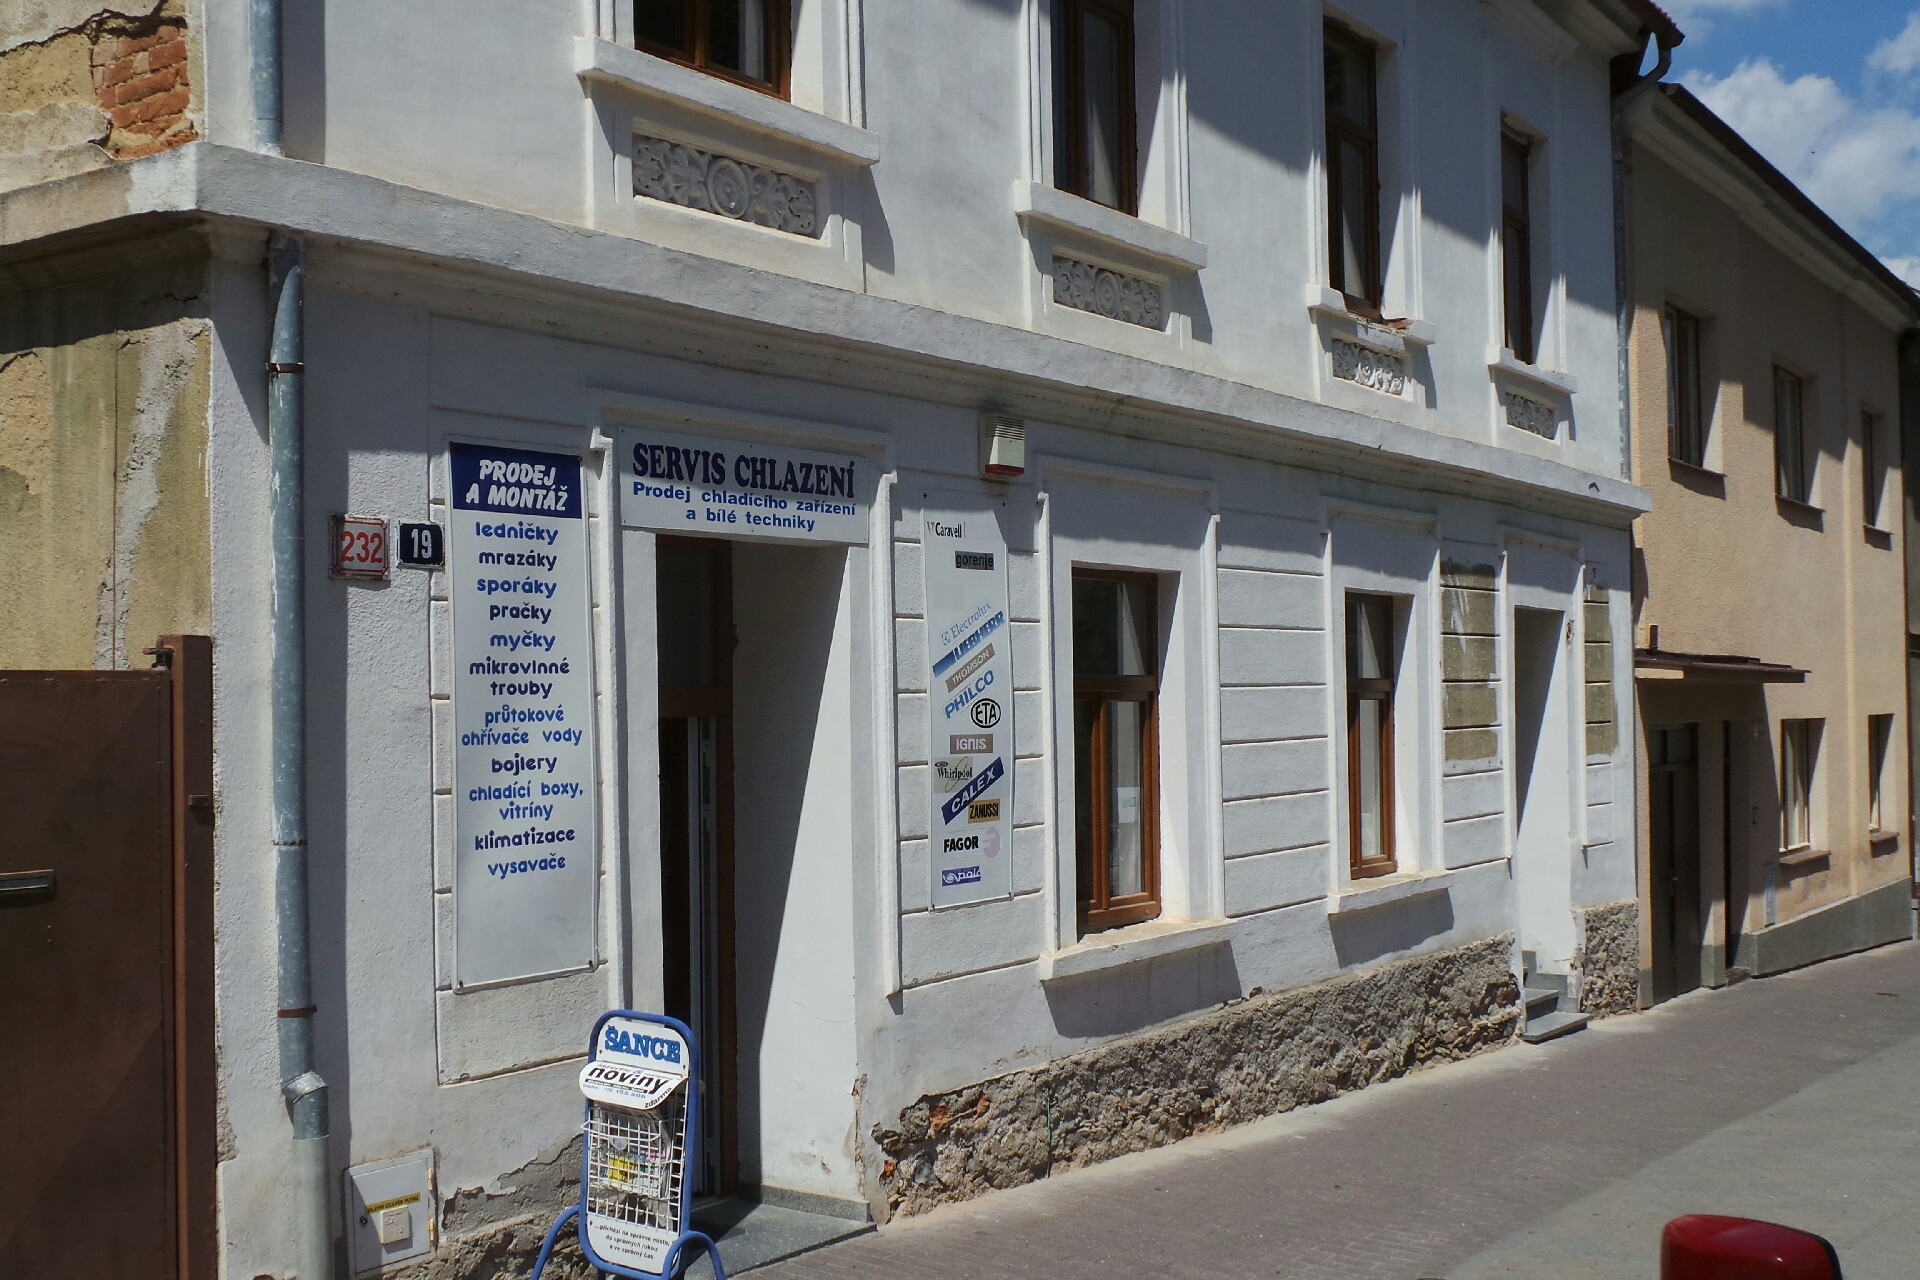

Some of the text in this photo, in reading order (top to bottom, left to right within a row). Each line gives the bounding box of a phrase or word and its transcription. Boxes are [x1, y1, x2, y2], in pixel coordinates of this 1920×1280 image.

[479, 459, 556, 486] PRODEJ
[632, 442, 855, 498] SERVIS CHLAZENÍ
[465, 483, 568, 511] A MONTÁŽ
[633, 481, 856, 516] Prodej chladícího zařízení
[686, 508, 816, 532] a bílé techniky
[935, 521, 962, 538] Caravell
[411, 528, 432, 559] 19
[475, 521, 559, 545] ledničky
[341, 530, 383, 564] 232
[478, 550, 557, 571] mrazáky
[956, 553, 994, 570] gorenje
[477, 575, 557, 598] sporáky
[490, 602, 552, 625] pračky
[950, 603, 991, 639] Electrolux
[490, 630, 556, 652] myčky
[952, 610, 1005, 661] LIEBHERR
[469, 656, 570, 675] mikrovlnné
[952, 649, 990, 685] THOMSON
[490, 680, 553, 699] trouby
[945, 670, 995, 719] PHILCO
[484, 704, 564, 727] průtokové
[975, 702, 997, 725] ETA
[461, 727, 583, 747] ohřívače vody
[491, 753, 558, 776] bojlery
[937, 766, 973, 780] Whirlpool
[469, 780, 584, 801] chladící boxy,
[951, 765, 996, 812] CALEX
[499, 801, 554, 821] vitríny
[969, 803, 999, 820] ZANUSSI
[475, 826, 575, 851] klimatizace
[944, 836, 979, 852] FAGOR
[487, 852, 566, 879] vysavače
[605, 1025, 680, 1064] ŠANCE
[588, 1067, 669, 1095] noviny
[645, 1086, 673, 1108] zdarma
[630, 1231, 652, 1241] správné
[643, 1252, 654, 1260] čas
